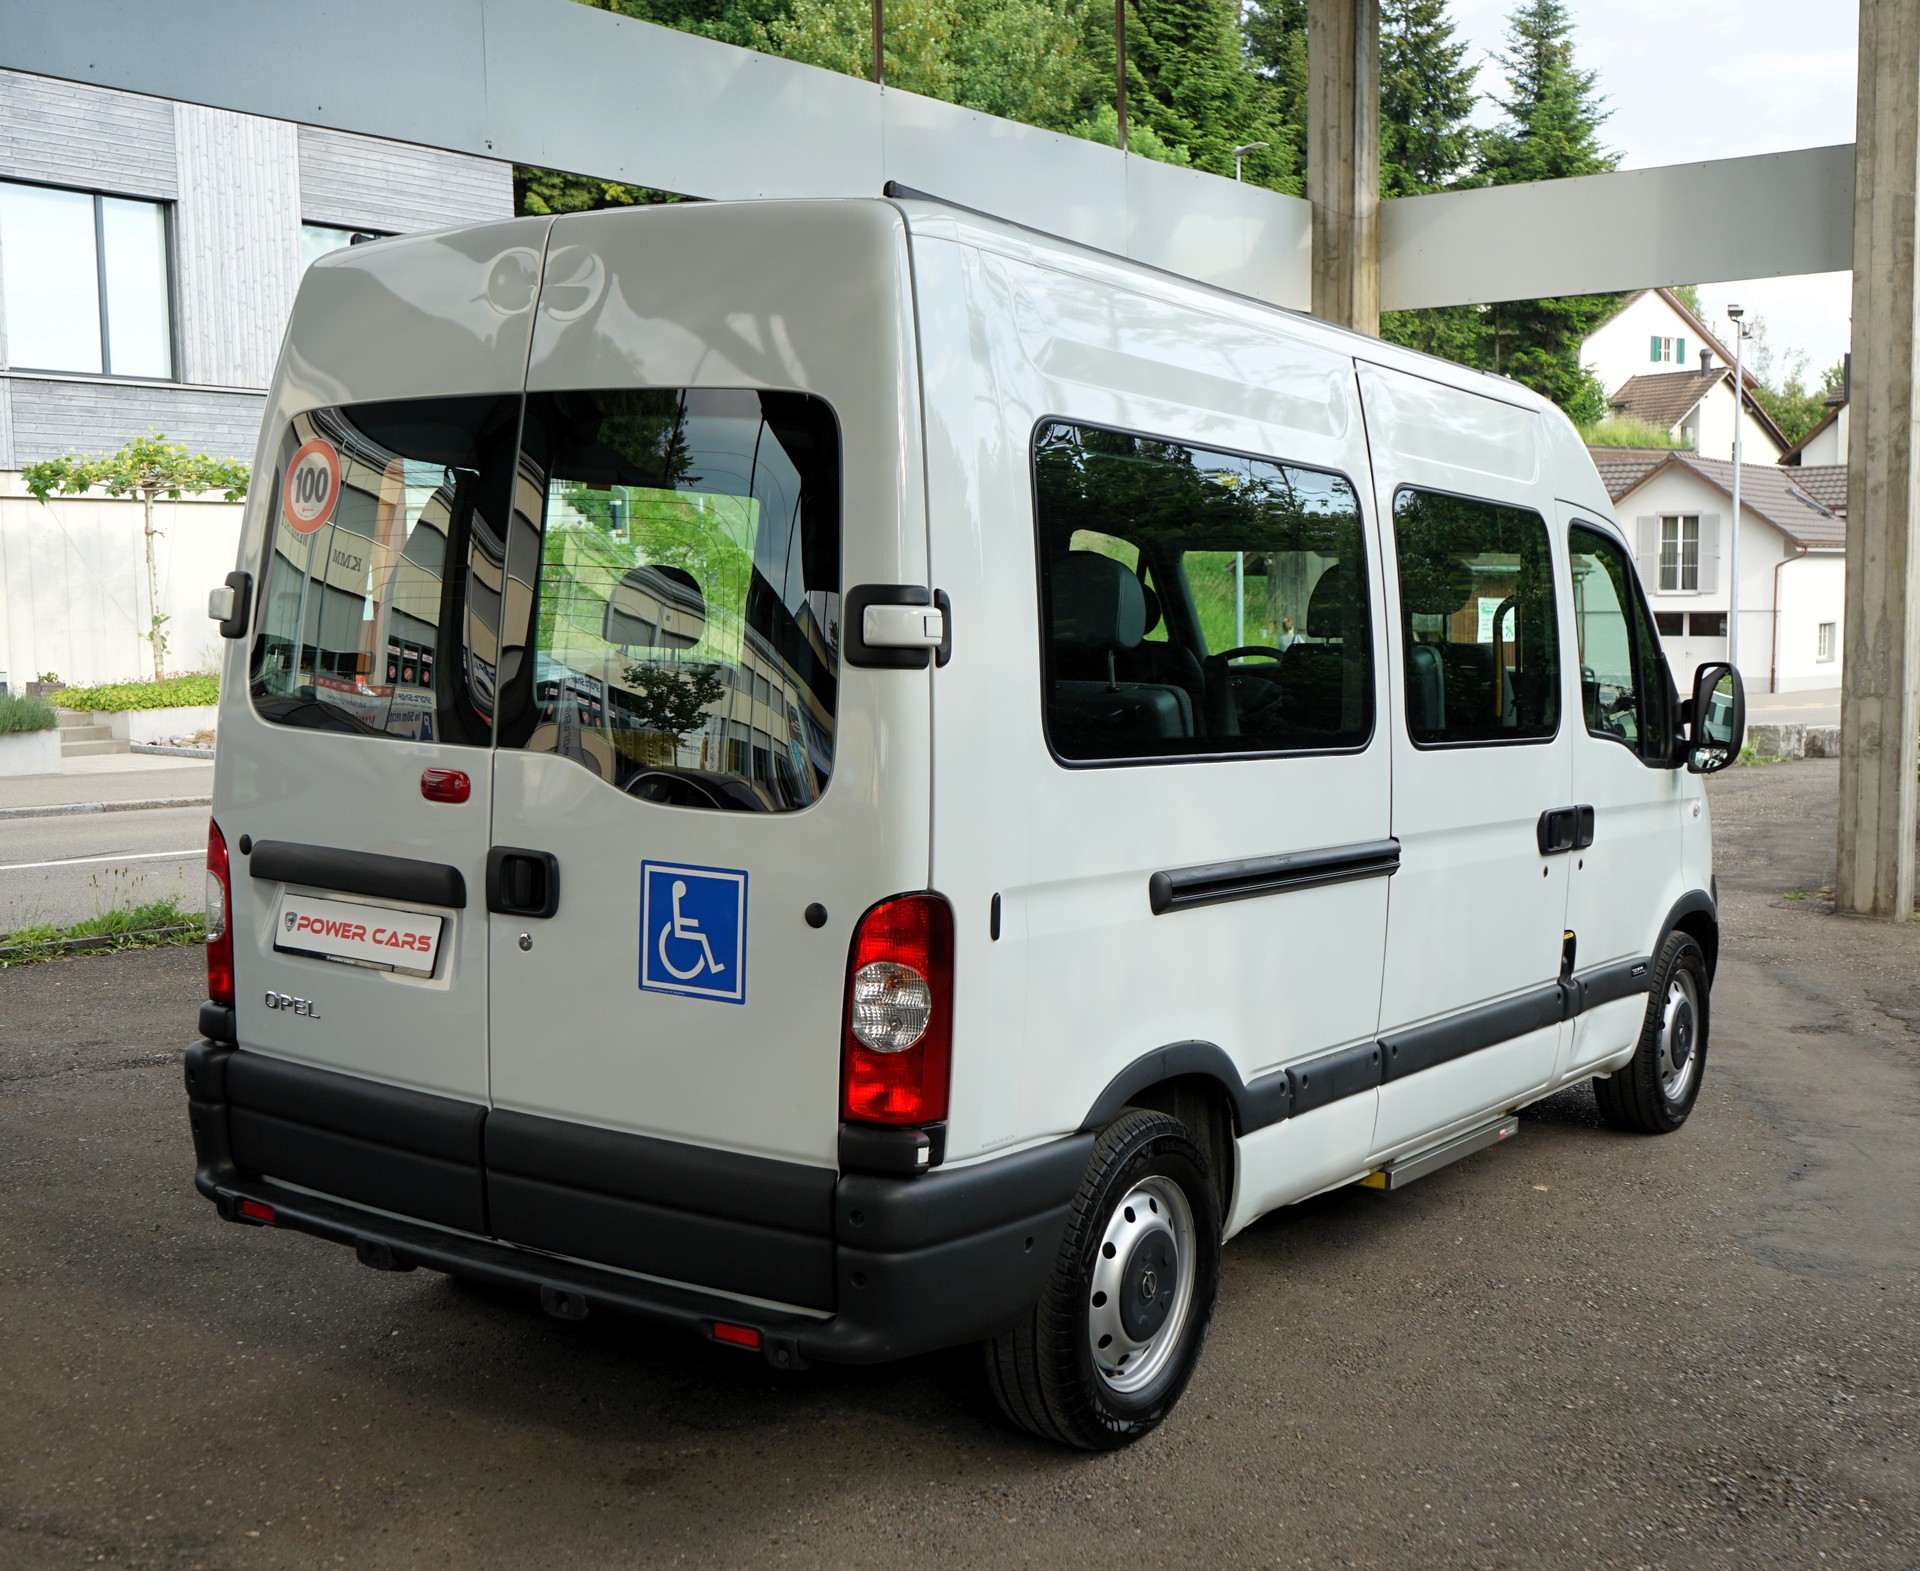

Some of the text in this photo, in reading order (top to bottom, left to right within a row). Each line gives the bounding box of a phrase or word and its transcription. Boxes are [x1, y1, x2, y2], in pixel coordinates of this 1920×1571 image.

[295, 467, 328, 503] 100
[296, 915, 432, 953] POWER CARS
[265, 990, 321, 1020] OPEL
